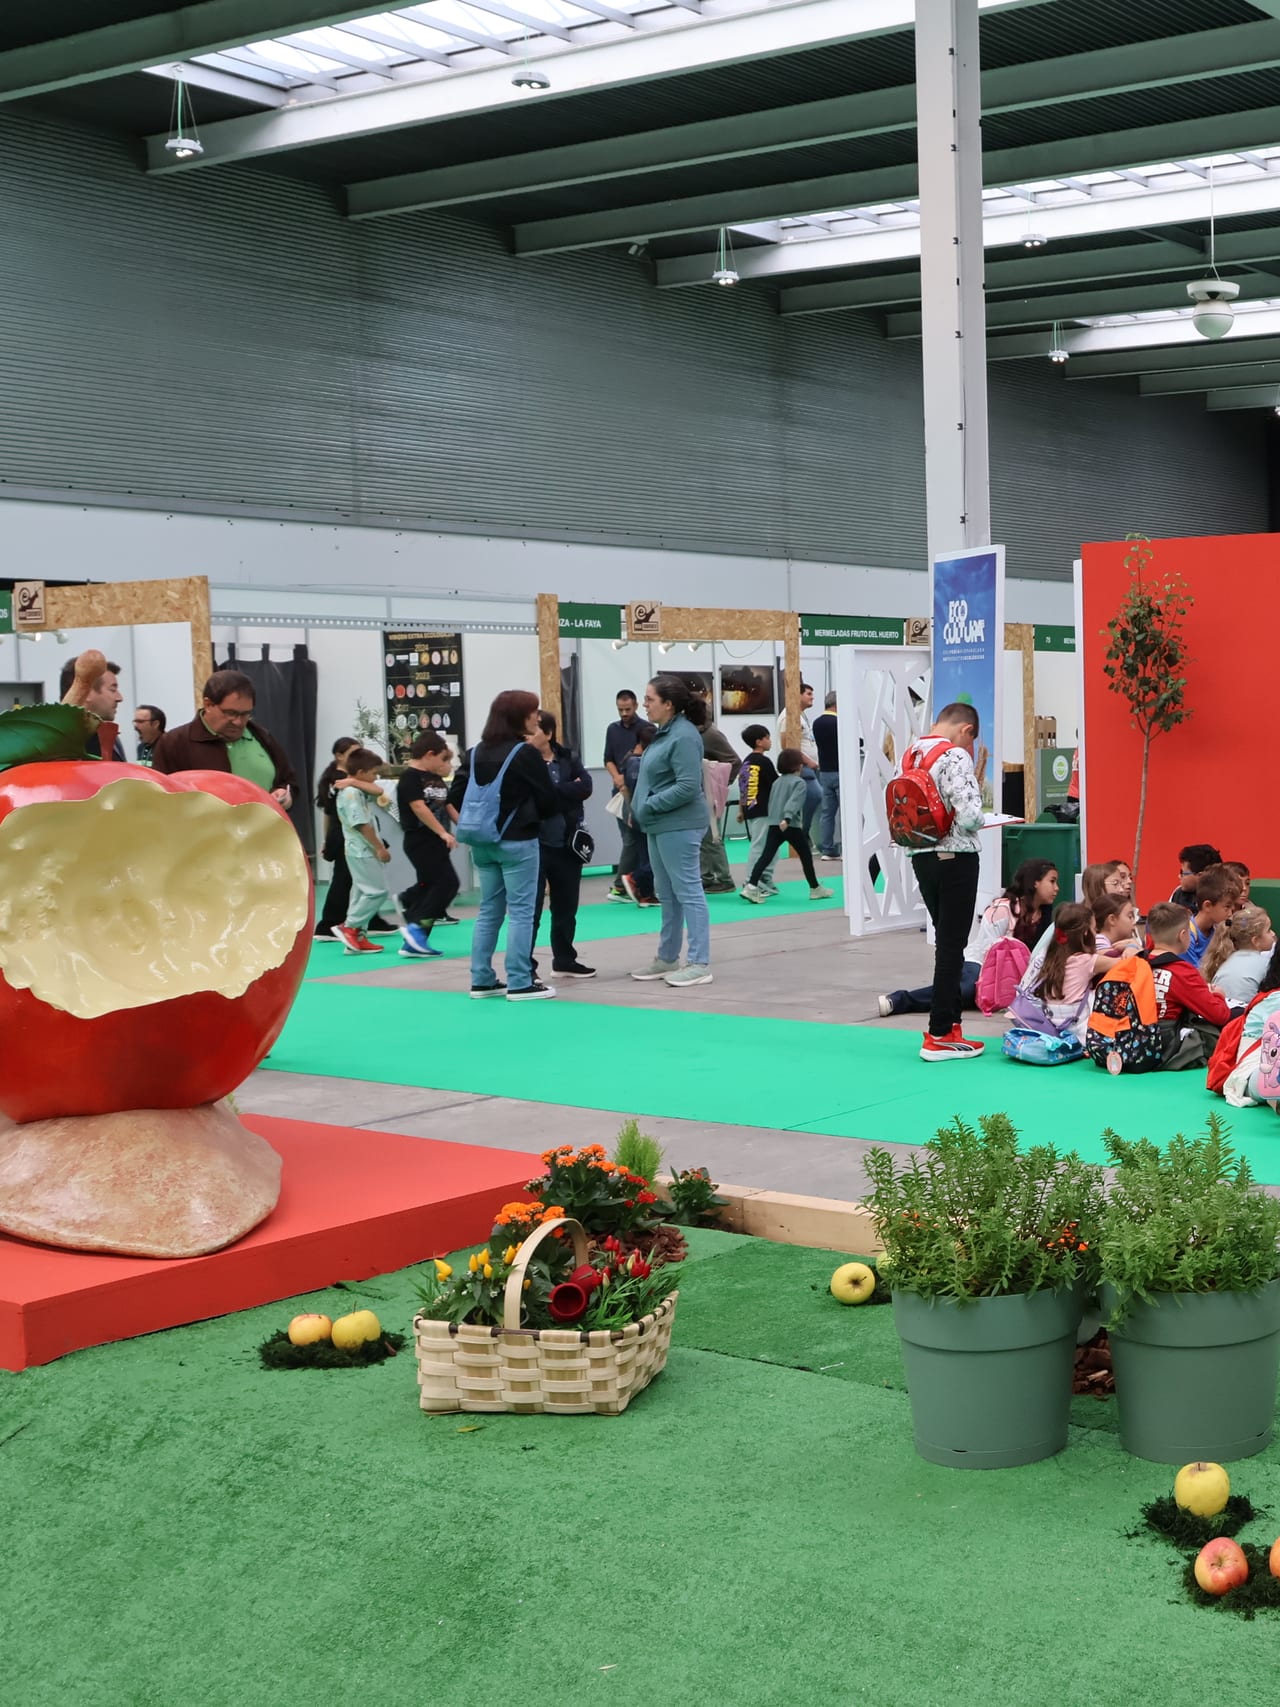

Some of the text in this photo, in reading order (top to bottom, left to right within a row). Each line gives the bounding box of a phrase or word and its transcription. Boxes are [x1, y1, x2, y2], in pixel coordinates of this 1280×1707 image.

[574, 618, 584, 628] LA
[585, 619, 602, 629] FAYA
[814, 629, 850, 638] MERMELADAS
[851, 630, 868, 638] FRUTO
[869, 630, 878, 638] DEL
[879, 631, 899, 639] HUERTO
[943, 619, 985, 645] CULTURA
